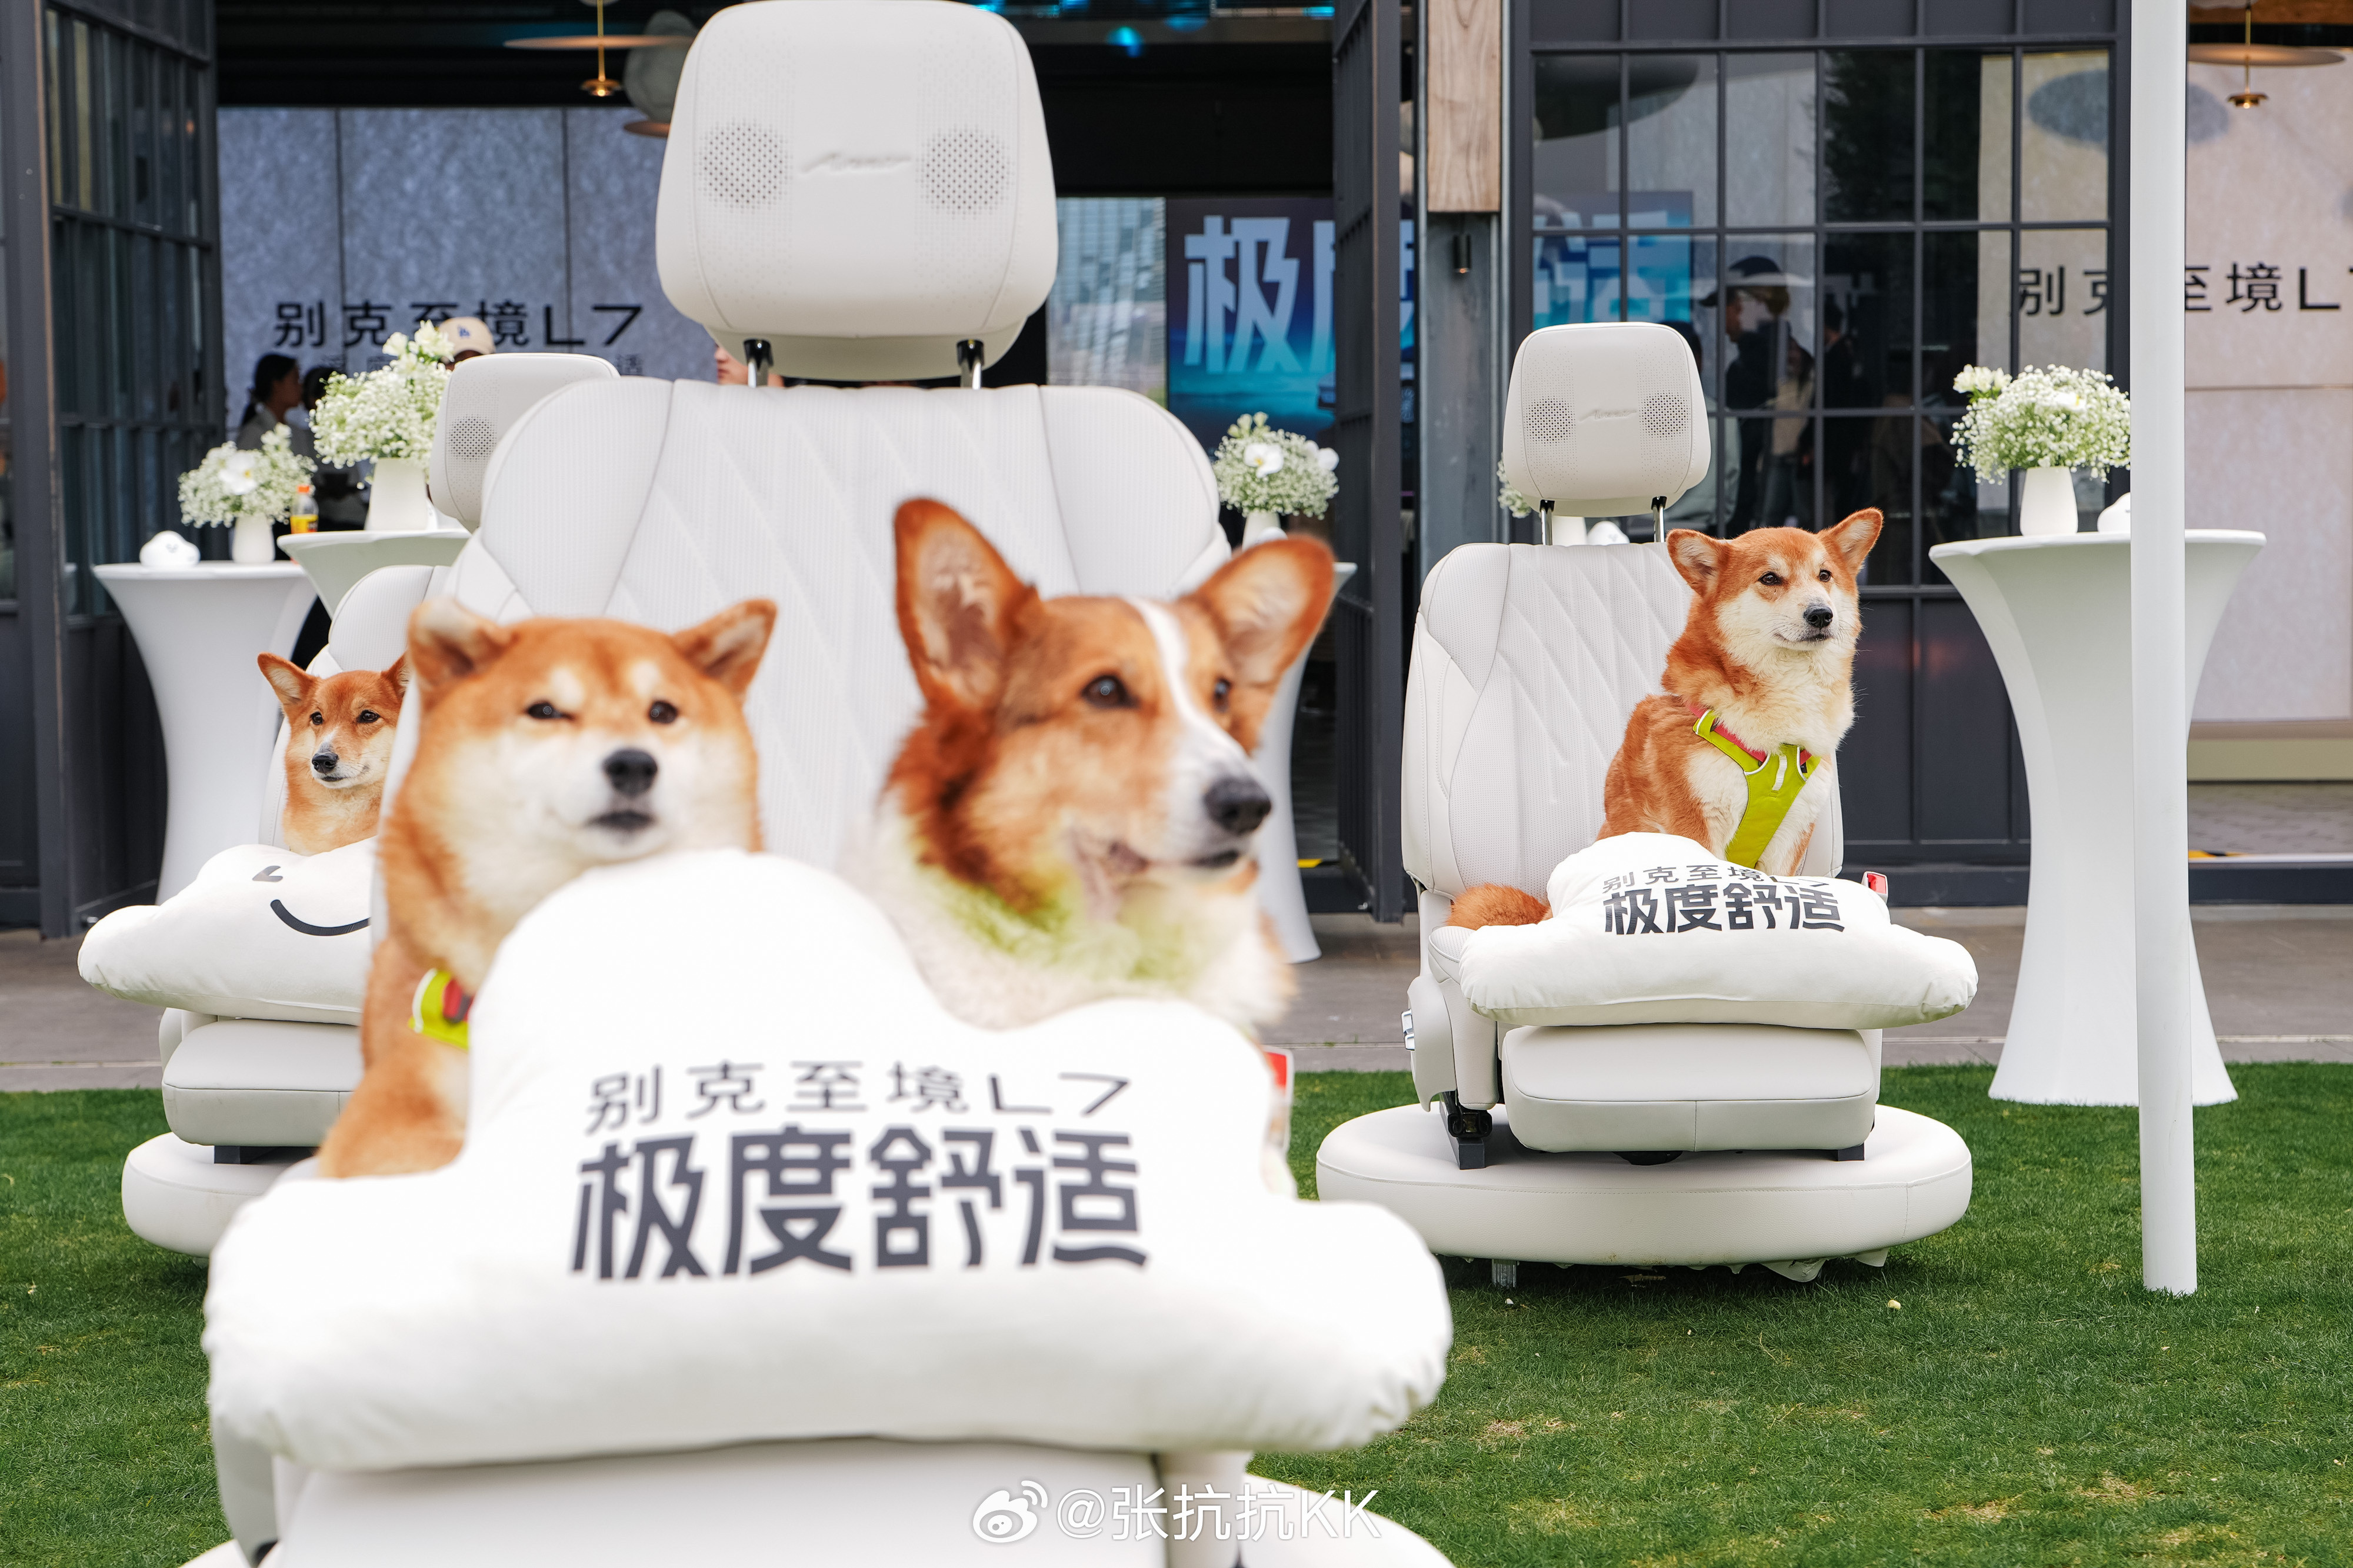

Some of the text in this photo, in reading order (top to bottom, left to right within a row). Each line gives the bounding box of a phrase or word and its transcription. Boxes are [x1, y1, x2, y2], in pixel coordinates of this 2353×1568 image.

[1602, 865, 1830, 894] 别克至境L7
[1602, 882, 1845, 935] 极度舒适
[586, 1061, 1132, 1134] 别克至境L7
[571, 1123, 1149, 1281] 极度舒适
